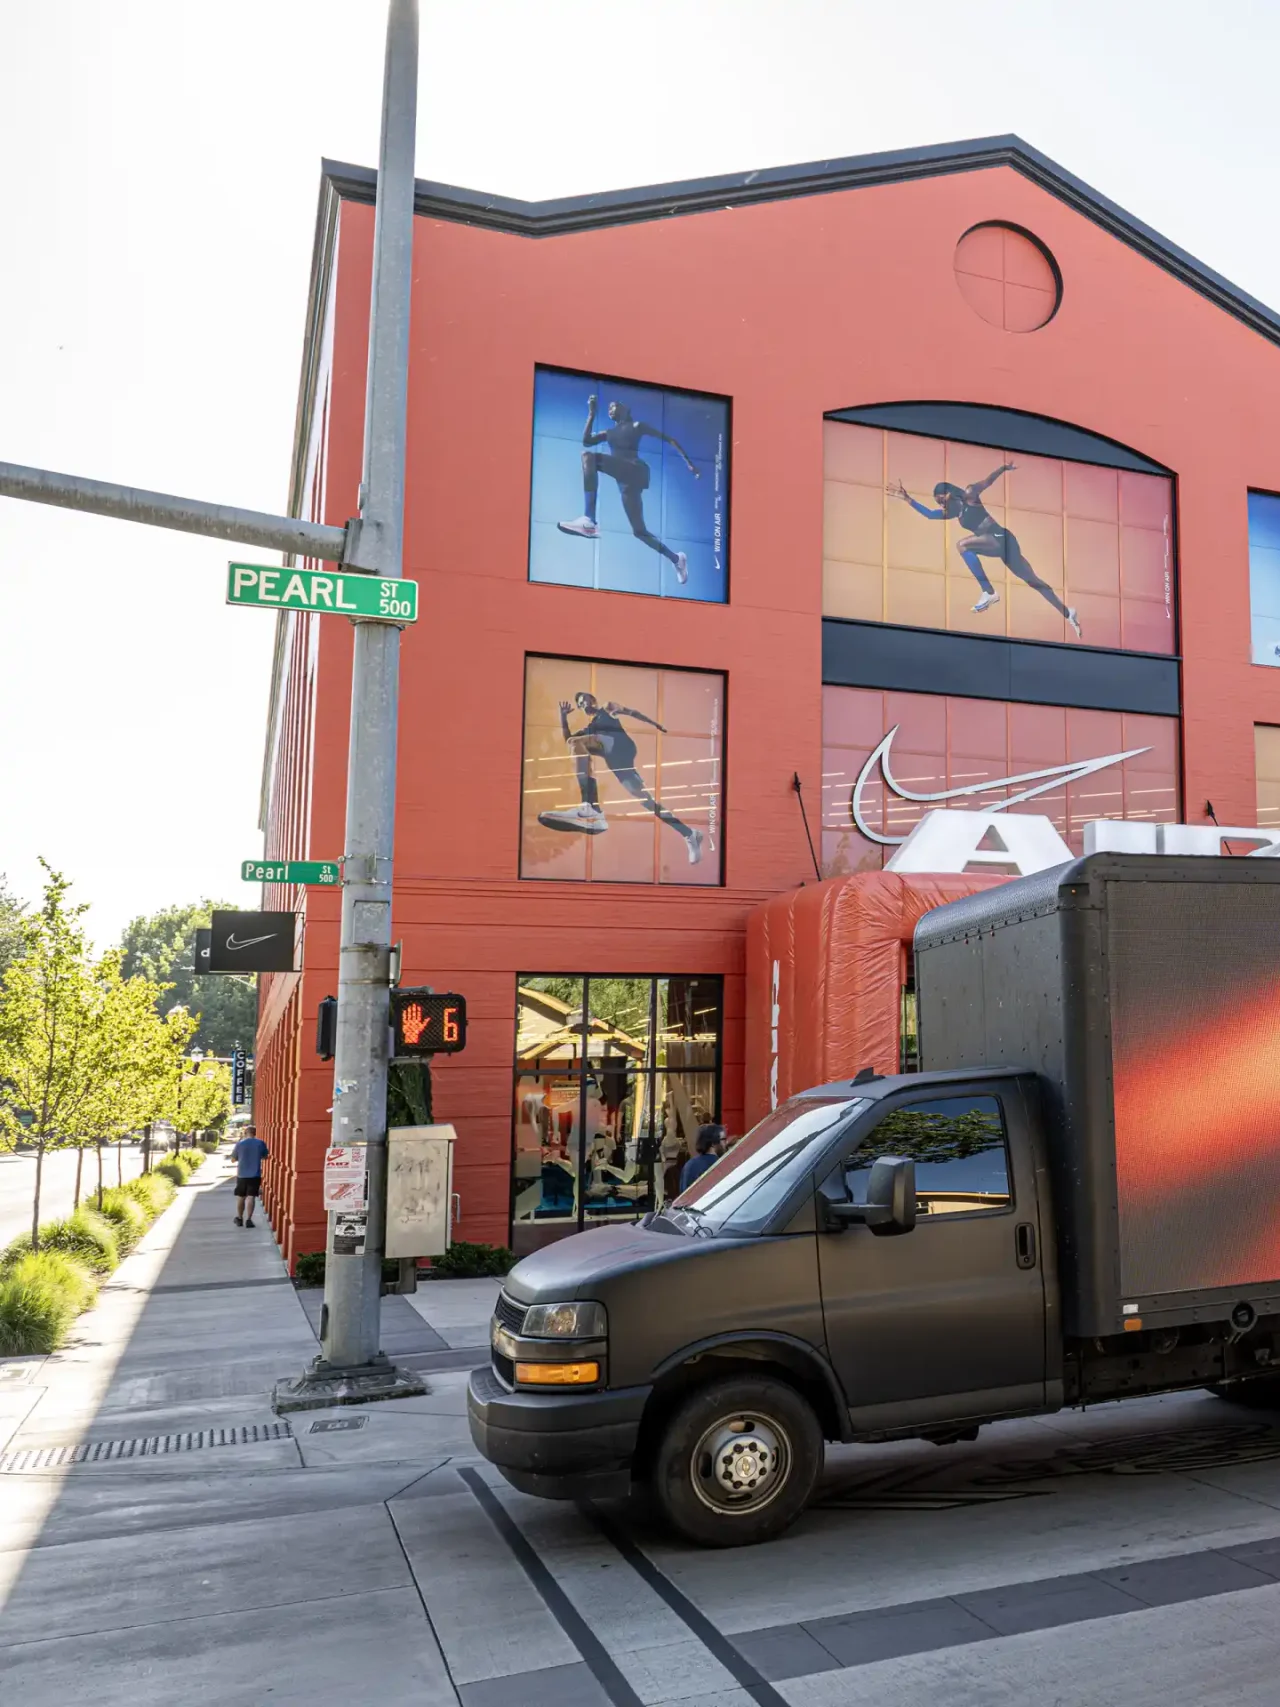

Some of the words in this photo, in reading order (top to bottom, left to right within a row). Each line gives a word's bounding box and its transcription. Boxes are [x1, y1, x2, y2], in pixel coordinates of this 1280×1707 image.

[714, 526, 721, 538] ON
[233, 568, 357, 609] PEARL
[380, 582, 399, 598] ST
[379, 599, 411, 616] 500
[245, 863, 289, 880] Pearl
[322, 866, 331, 874] St
[319, 874, 333, 882] 500
[443, 1007, 459, 1042] 6
[236, 1051, 245, 1103] COFFEE
